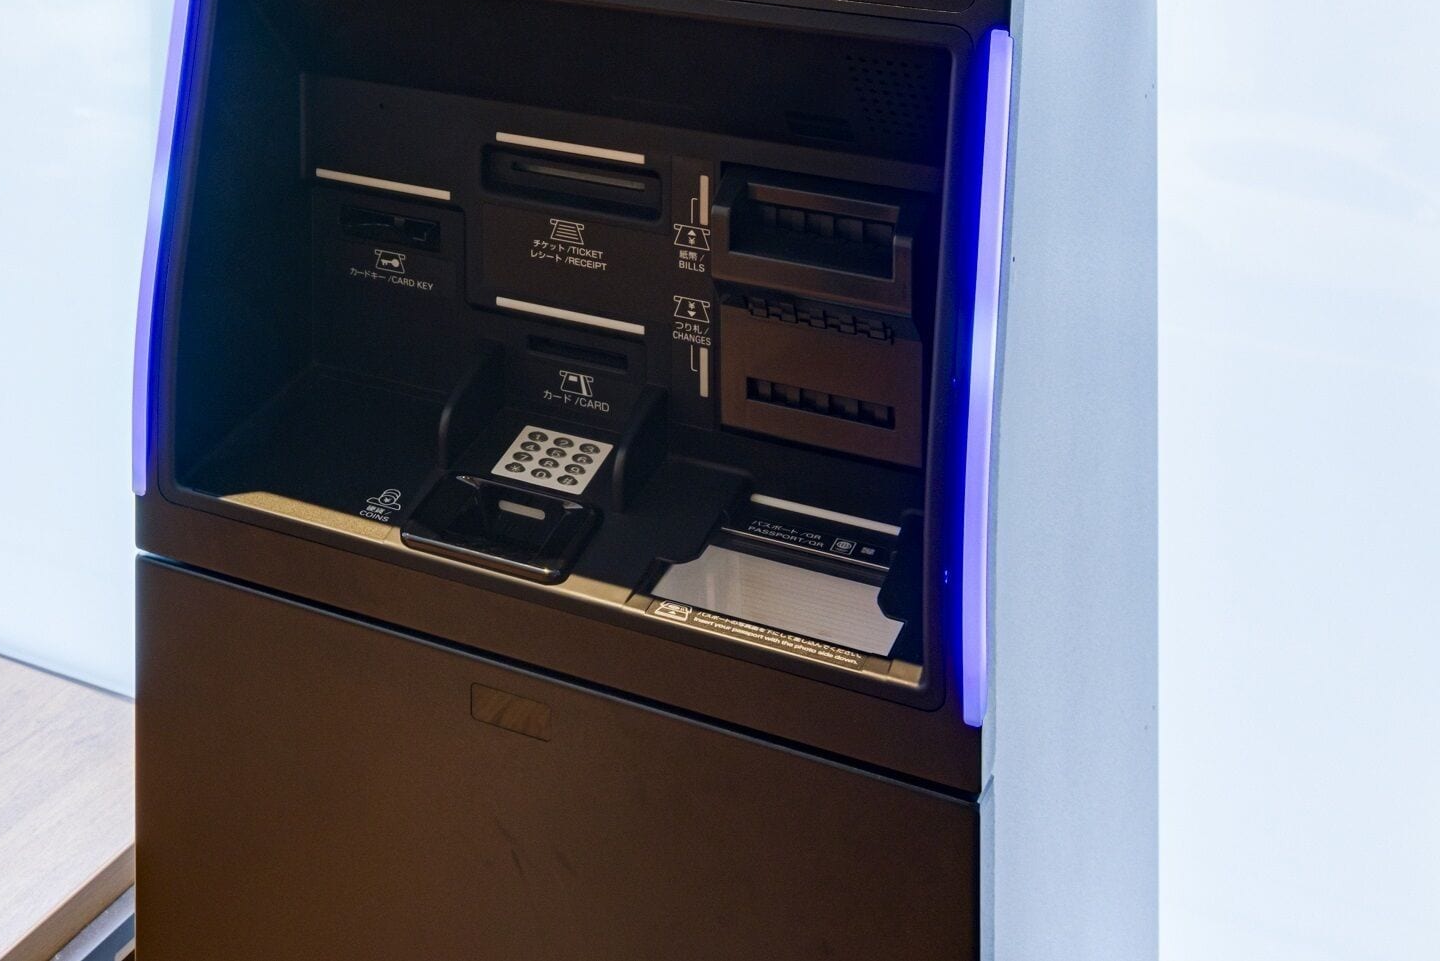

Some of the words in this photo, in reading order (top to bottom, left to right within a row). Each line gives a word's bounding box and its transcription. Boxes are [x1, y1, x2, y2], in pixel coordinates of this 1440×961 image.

[533, 239, 565, 252] チケット
[530, 249, 563, 263] レシート
[678, 260, 706, 273] BILLS
[349, 266, 387, 280] カードキー
[416, 280, 434, 291] KEY
[672, 330, 712, 346] CHANGES
[543, 389, 572, 404] カード
[359, 509, 390, 522] COINS
[751, 520, 799, 535] パスポート
[714, 622, 732, 632] your
[794, 643, 817, 653] photo
